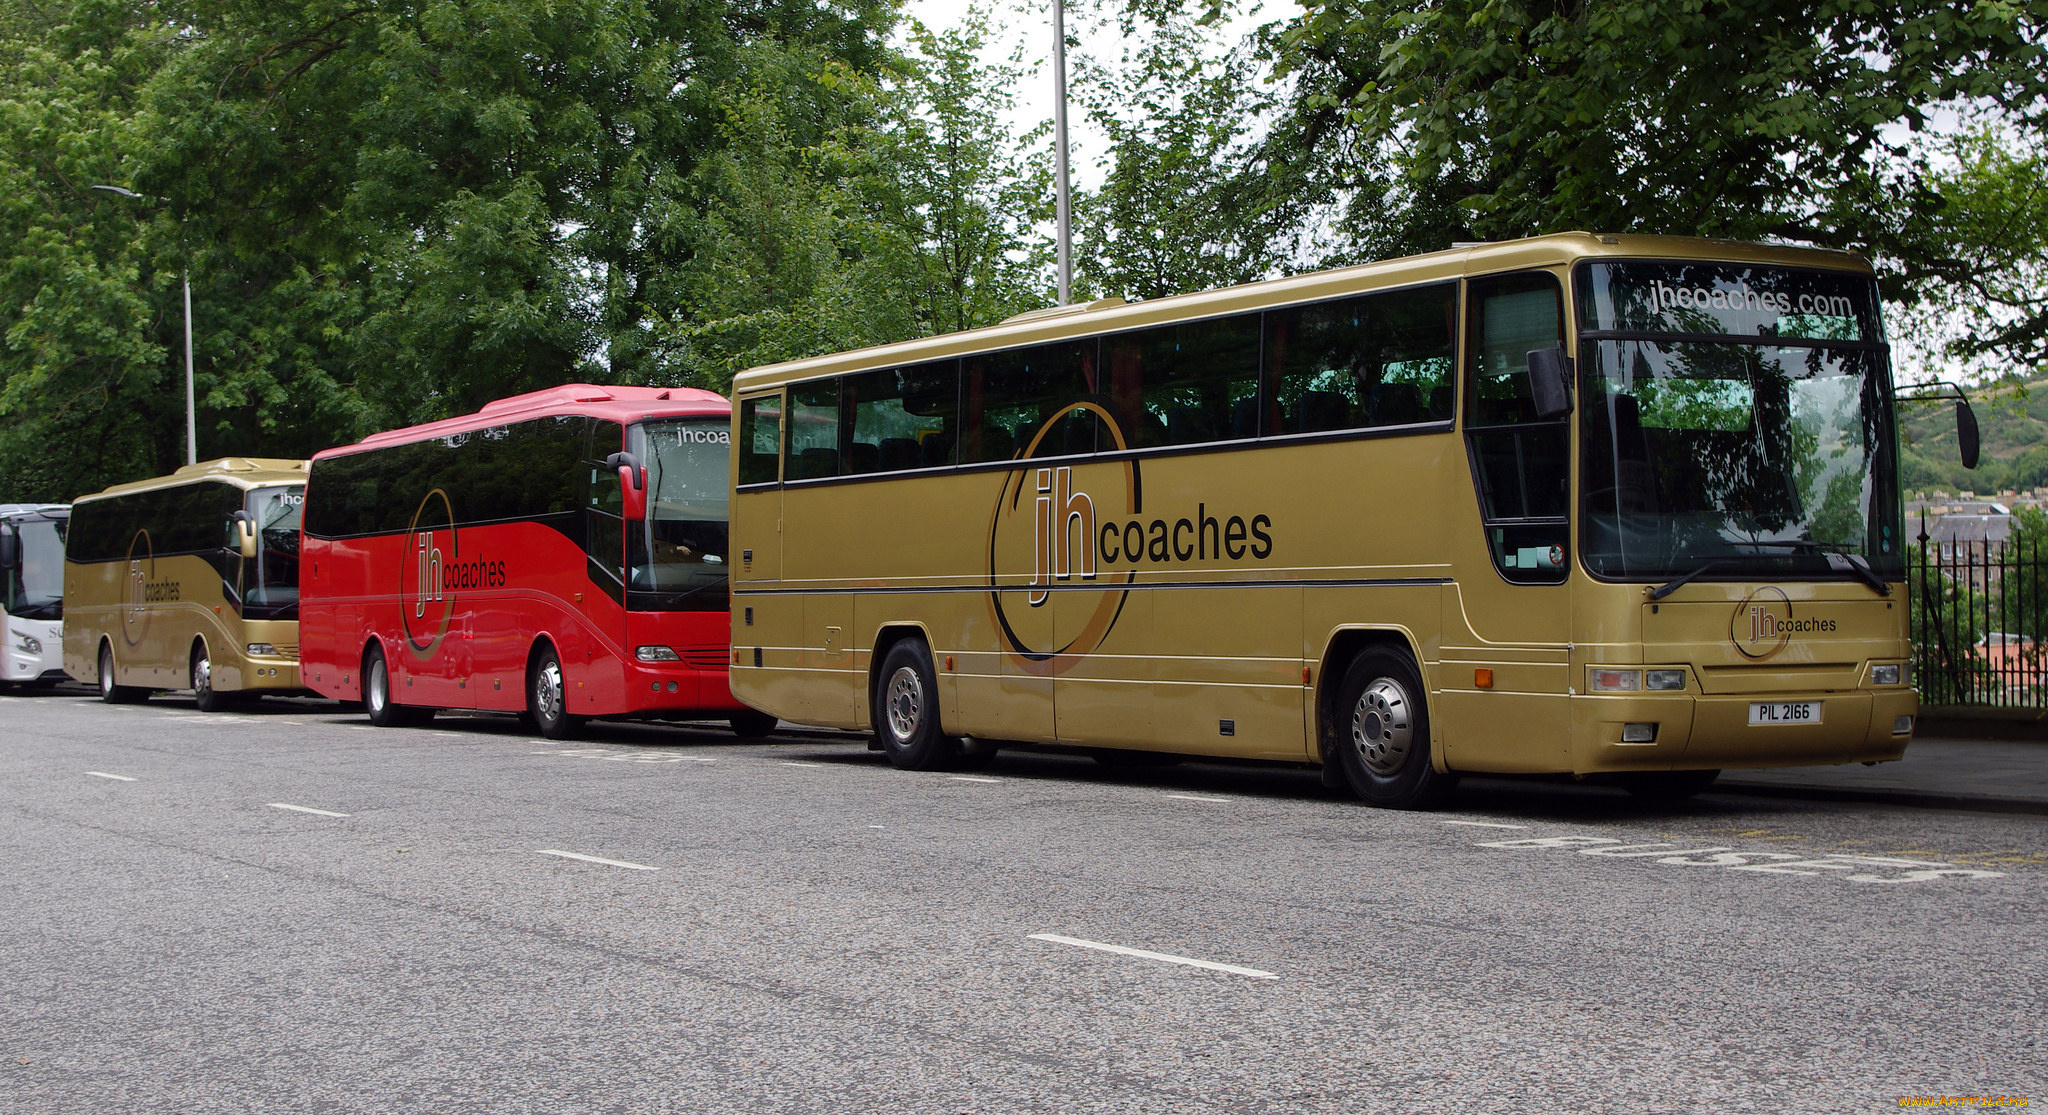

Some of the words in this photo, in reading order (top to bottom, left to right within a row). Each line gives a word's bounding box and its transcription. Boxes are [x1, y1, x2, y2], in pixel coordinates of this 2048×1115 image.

[1649, 280, 1853, 316] jhcoaches.com
[280, 493, 305, 508] jhc
[1101, 503, 1273, 563] coaches
[444, 553, 506, 590] coaches
[145, 576, 180, 602] coaches
[1777, 616, 1837, 634] coaches
[1760, 705, 1778, 720] PIL
[1783, 704, 1810, 720] 2166
[1473, 836, 2009, 884] BUSES
